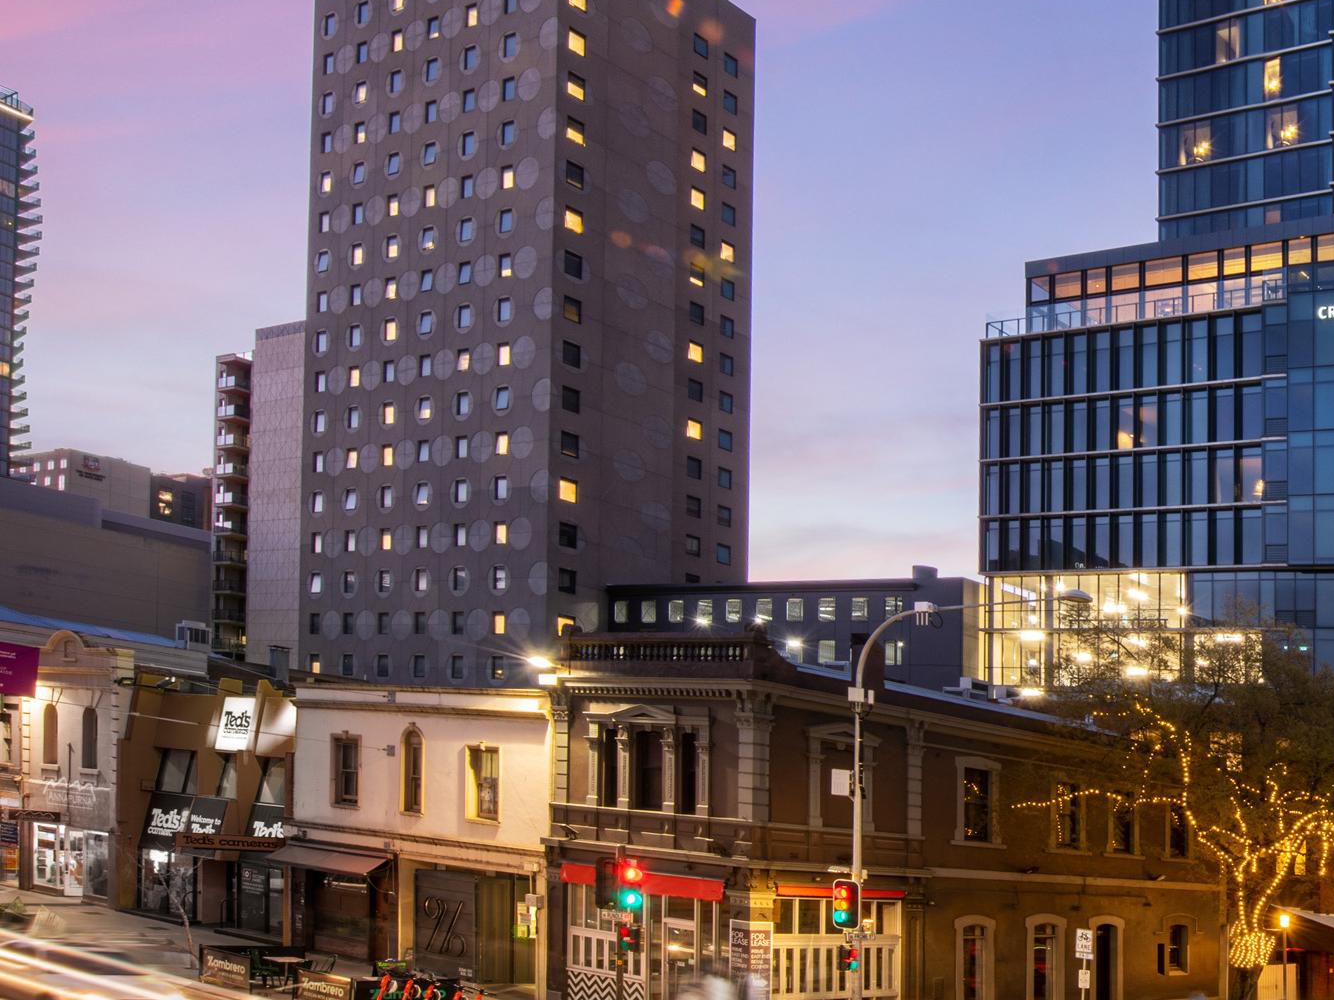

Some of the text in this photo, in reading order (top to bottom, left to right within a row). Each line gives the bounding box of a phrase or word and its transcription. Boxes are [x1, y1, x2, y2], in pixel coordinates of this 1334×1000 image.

[224, 710, 251, 728] Ted's
[151, 808, 180, 829] Ted's
[191, 814, 214, 824] Welcome
[184, 835, 279, 849] Ted's cameras
[731, 938, 749, 946] LEASE
[207, 955, 246, 974] Zambrero
[302, 977, 344, 997] Zambrero
